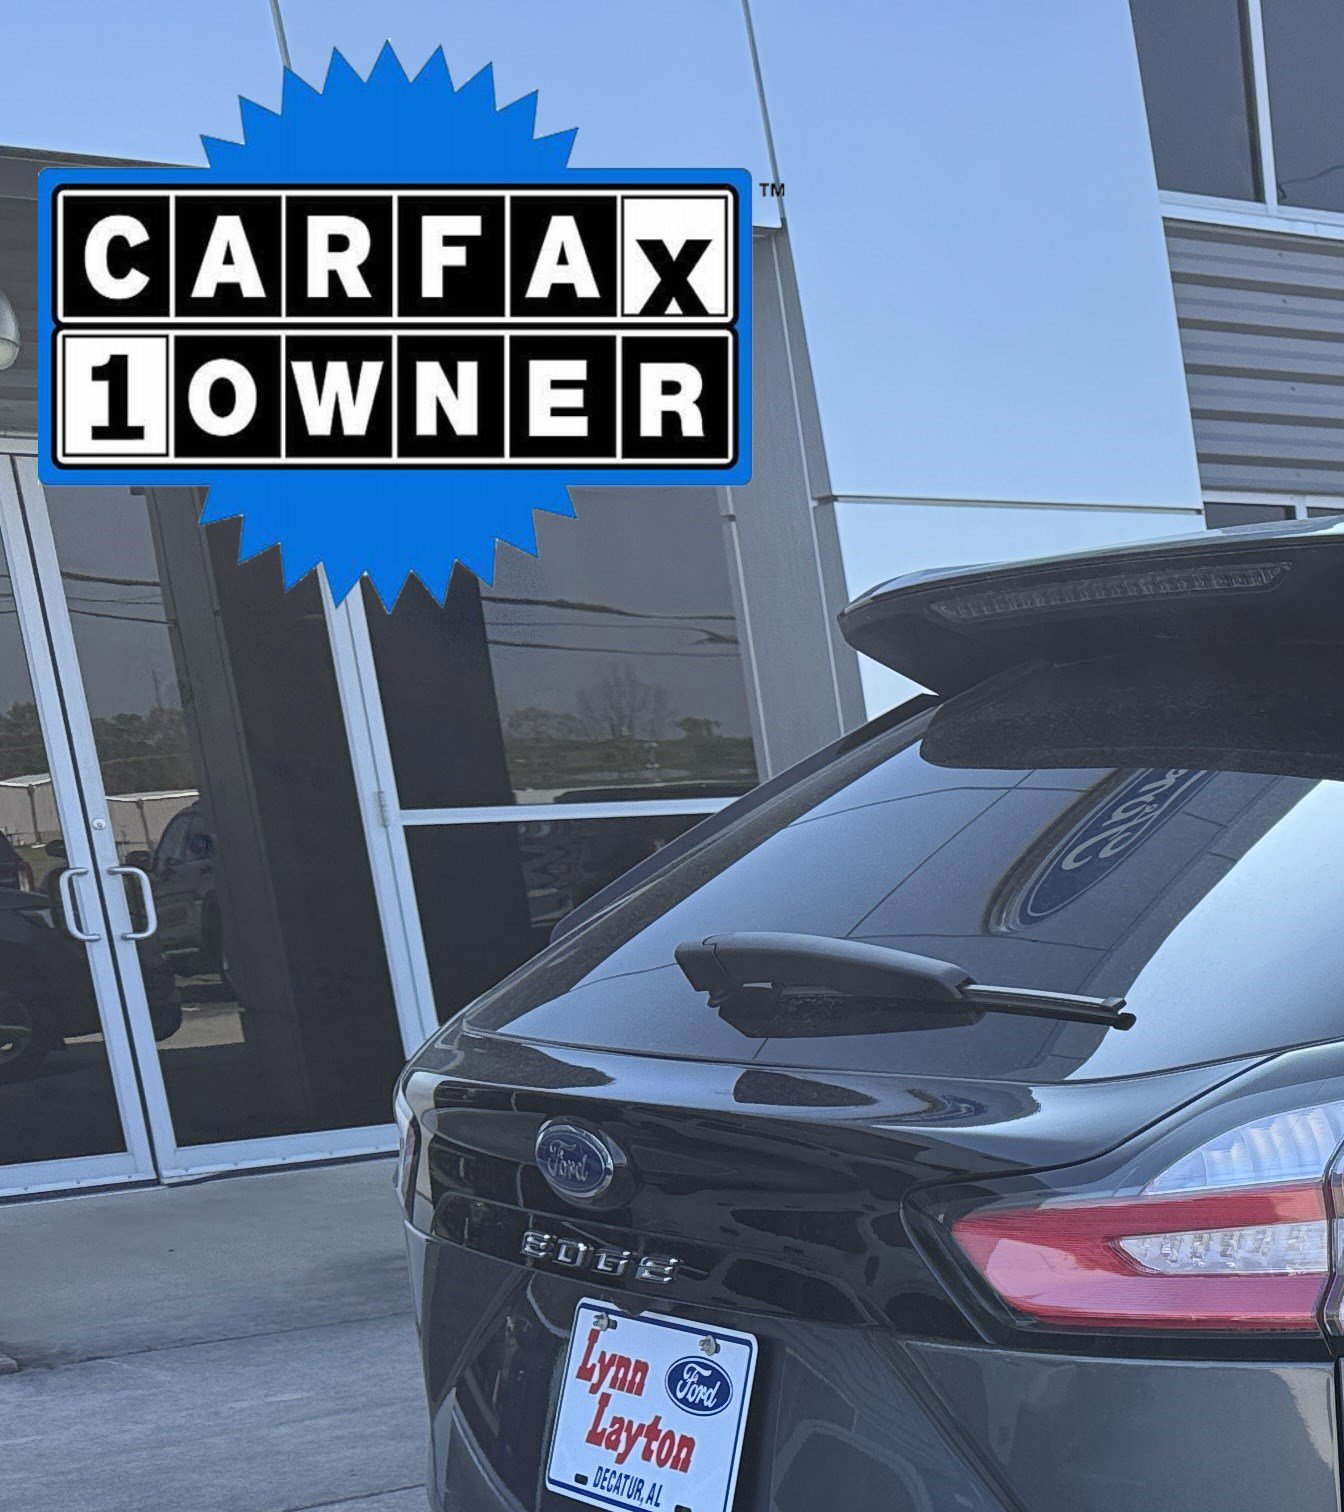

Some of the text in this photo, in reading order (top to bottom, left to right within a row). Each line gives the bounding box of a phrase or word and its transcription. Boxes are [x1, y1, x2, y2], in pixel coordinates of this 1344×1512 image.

[547, 1139, 589, 1182] Ford
[521, 1230, 680, 1285] EDGE
[576, 1328, 649, 1396] Lynn
[676, 1363, 720, 1407] Ford
[585, 1392, 696, 1474] Layton
[592, 1465, 664, 1508] DECATUR, AL
